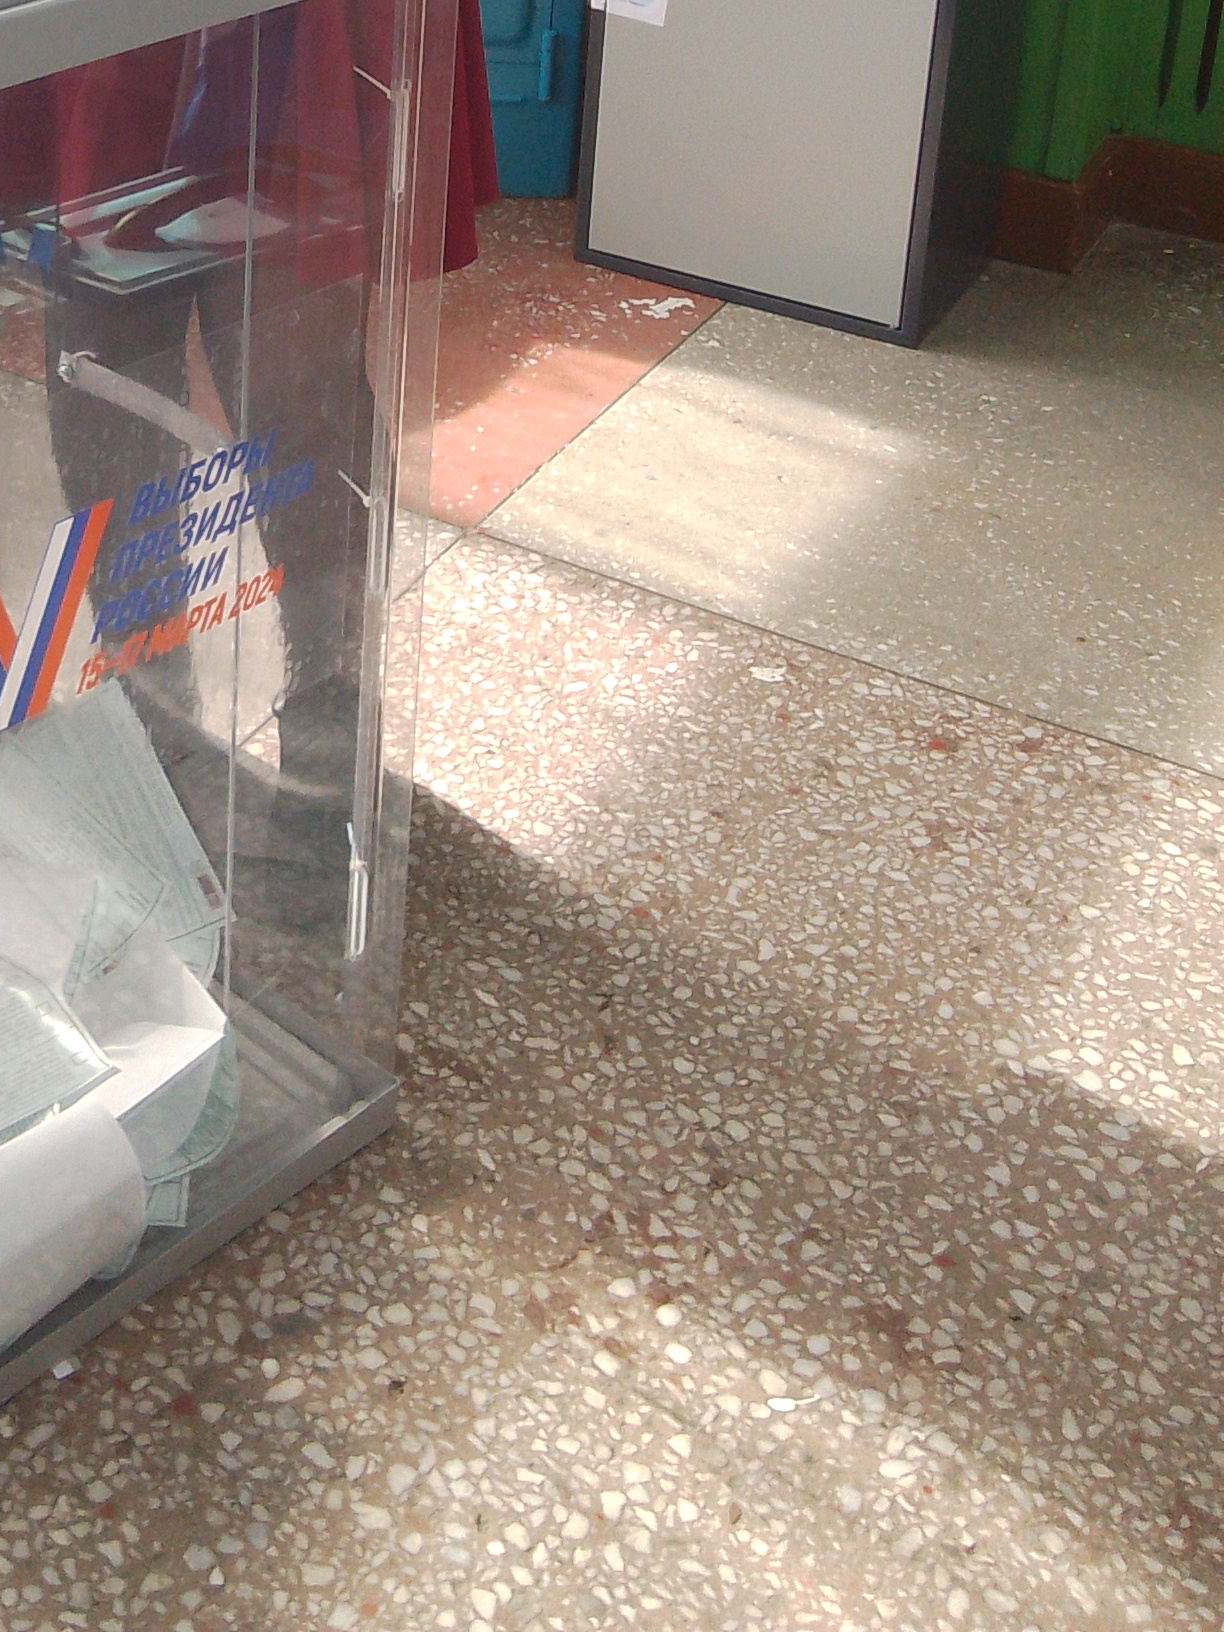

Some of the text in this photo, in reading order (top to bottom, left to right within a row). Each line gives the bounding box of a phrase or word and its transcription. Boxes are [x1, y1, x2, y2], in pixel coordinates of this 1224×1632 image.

[109, 457, 315, 586] ПРЕЗИДЕНТА
[127, 426, 278, 527] ВЫБОРЫ
[90, 545, 230, 645] РОССИИ
[145, 591, 228, 664] МАРТА
